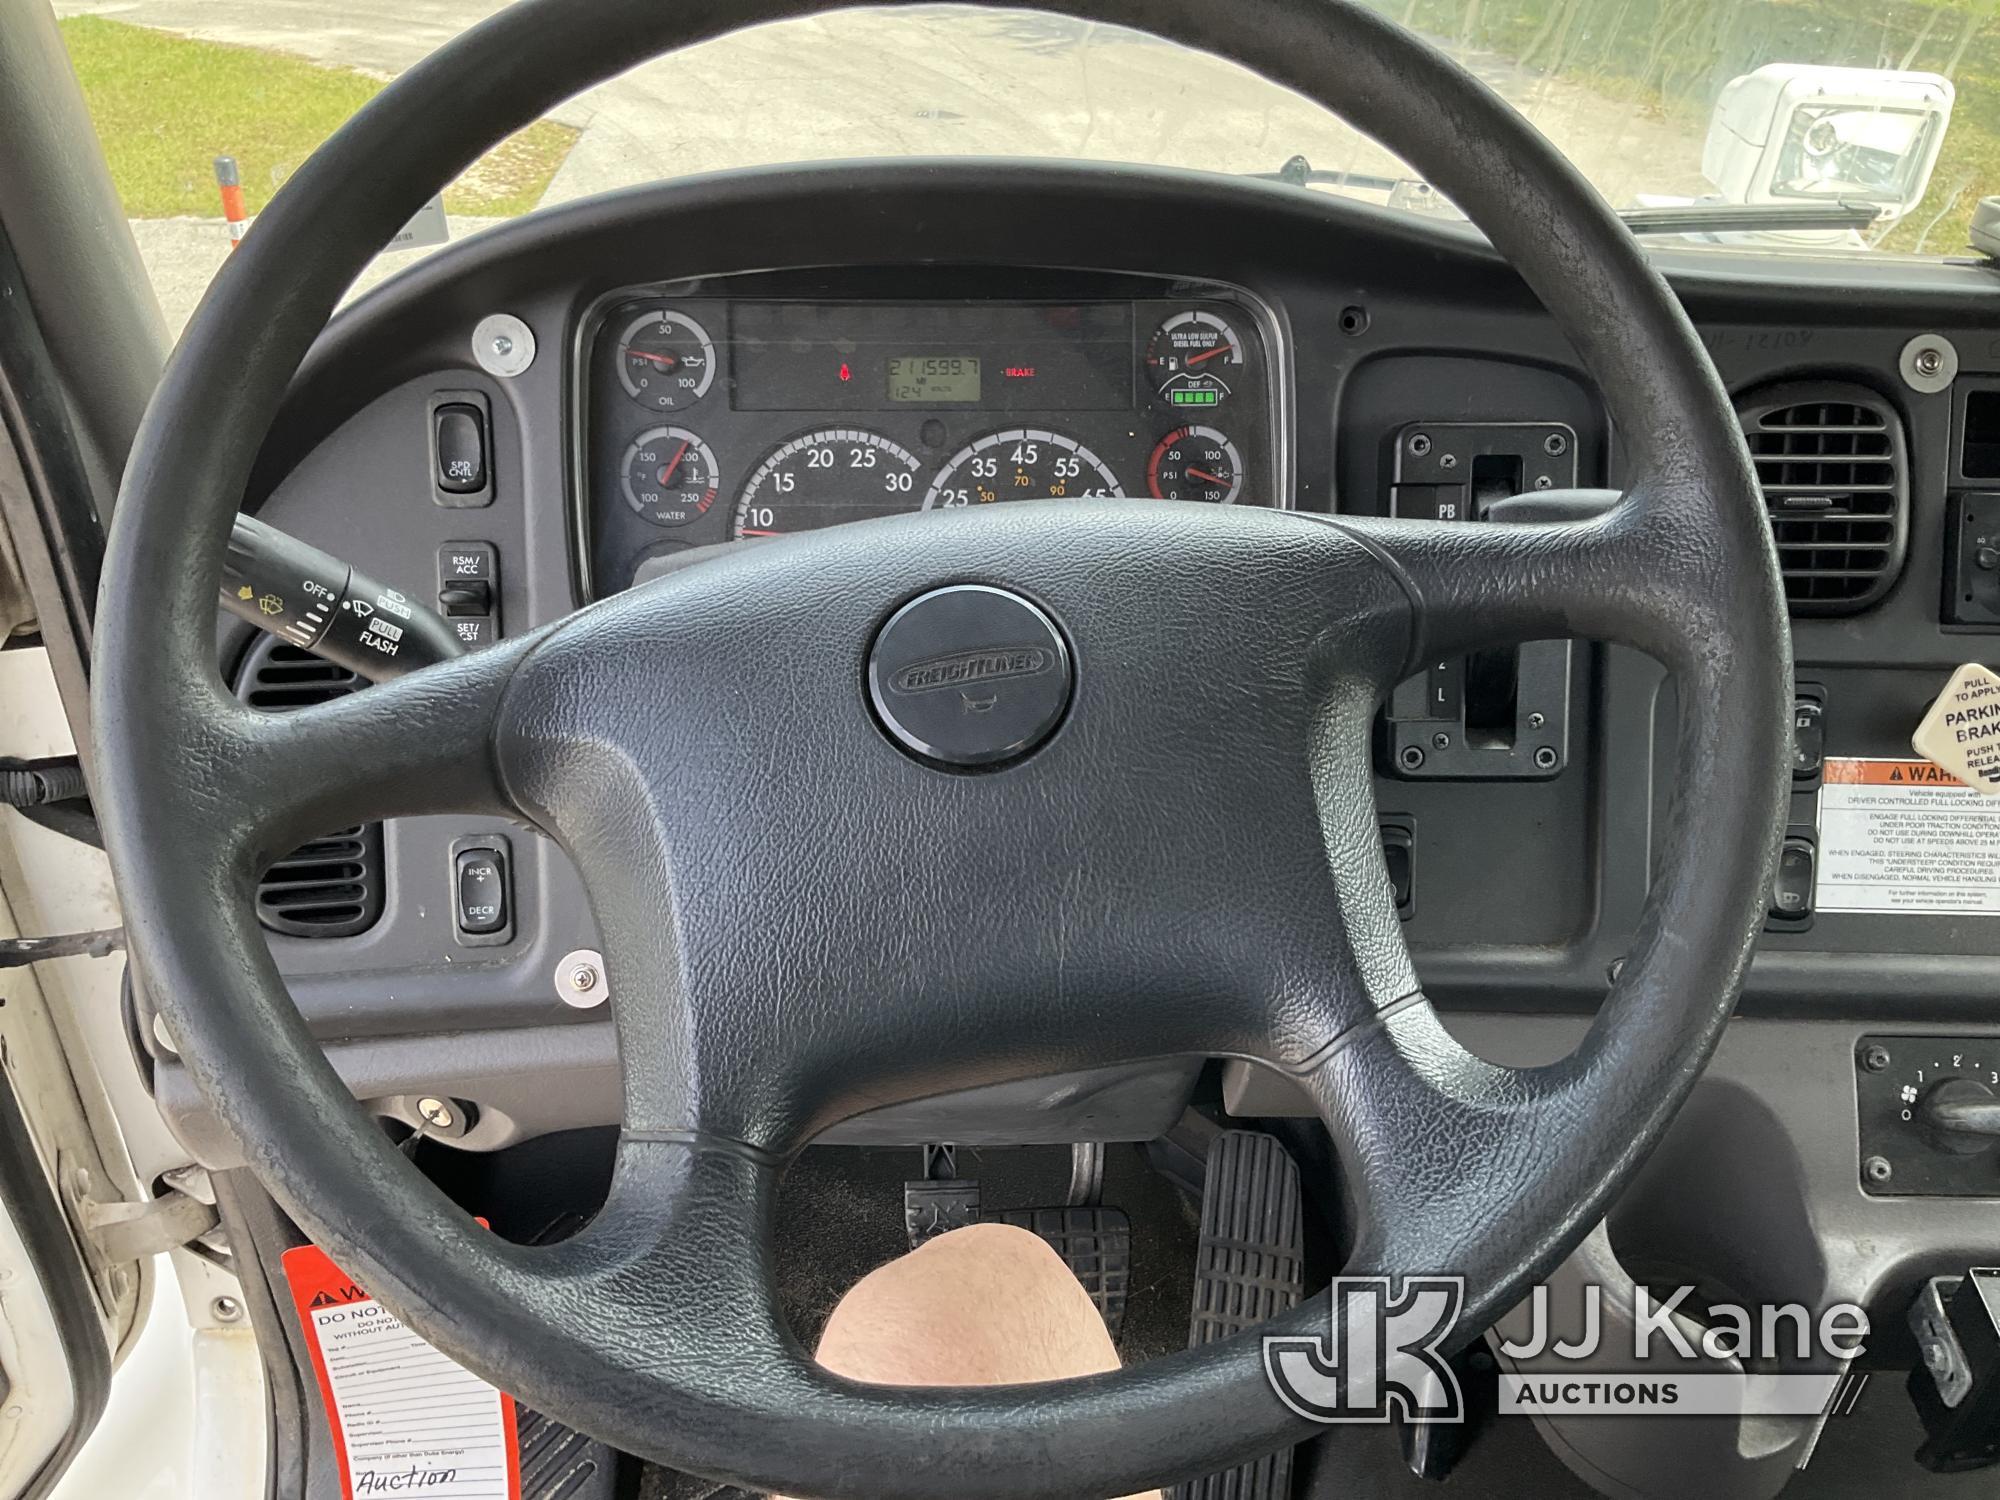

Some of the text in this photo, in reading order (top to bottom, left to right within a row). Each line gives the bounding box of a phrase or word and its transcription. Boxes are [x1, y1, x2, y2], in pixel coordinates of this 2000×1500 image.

[658, 324, 672, 335] 50
[1174, 340, 1216, 348] DIESEL FUEL ONLY
[632, 358, 648, 367] PSI
[1159, 356, 1165, 366] E
[1223, 355, 1229, 365] F
[1005, 367, 1035, 377] BRAKE
[640, 378, 649, 388] 0
[678, 378, 696, 388] 100
[1187, 380, 1201, 389] DEF
[658, 396, 675, 406] OIL
[639, 452, 657, 462] 150
[807, 448, 835, 468] 20
[850, 448, 877, 468] 25
[1010, 444, 1038, 465] 45
[1167, 451, 1181, 461] 50
[1204, 450, 1221, 460] 100
[451, 461, 471, 469] SPD
[971, 457, 998, 478] 35
[1053, 457, 1081, 478] 55
[448, 468, 473, 477] CNTL
[1162, 471, 1178, 480] PSI
[773, 473, 796, 493] 15
[885, 472, 913, 492] 30
[1014, 475, 1029, 487] 70
[1050, 485, 1065, 496] 90
[1169, 491, 1177, 500] 0
[1204, 491, 1221, 500] 150
[640, 493, 659, 503] 100
[680, 493, 700, 503] 250
[942, 489, 969, 508] 25
[980, 491, 995, 502] 50
[656, 511, 686, 520] WATER
[1438, 504, 1456, 520] PB
[750, 508, 774, 528] 10
[456, 565, 479, 574] ACC
[303, 580, 329, 597] OFF
[379, 597, 411, 618] PUSH
[371, 619, 401, 639] PULL
[359, 631, 399, 656] FLASH
[905, 654, 1038, 688] FREIGHTLINER
[1964, 677, 1990, 689] PULL
[1438, 687, 1446, 702] L
[1955, 692, 1969, 702] TO
[1966, 744, 1994, 758] PUSH
[1909, 788, 1982, 799] Vehicle equipped with
[468, 867, 492, 876] INCR
[468, 906, 495, 915] DECR
[1953, 1055, 1962, 1068] 2
[1917, 1070, 1924, 1083] 1
[1991, 1071, 1999, 1084] 3
[1901, 1108, 1912, 1121] 0
[318, 1312, 346, 1326] DO
[357, 1320, 375, 1329] DO
[333, 1326, 382, 1340] WITHOUT
[356, 1464, 457, 1495] Auction
